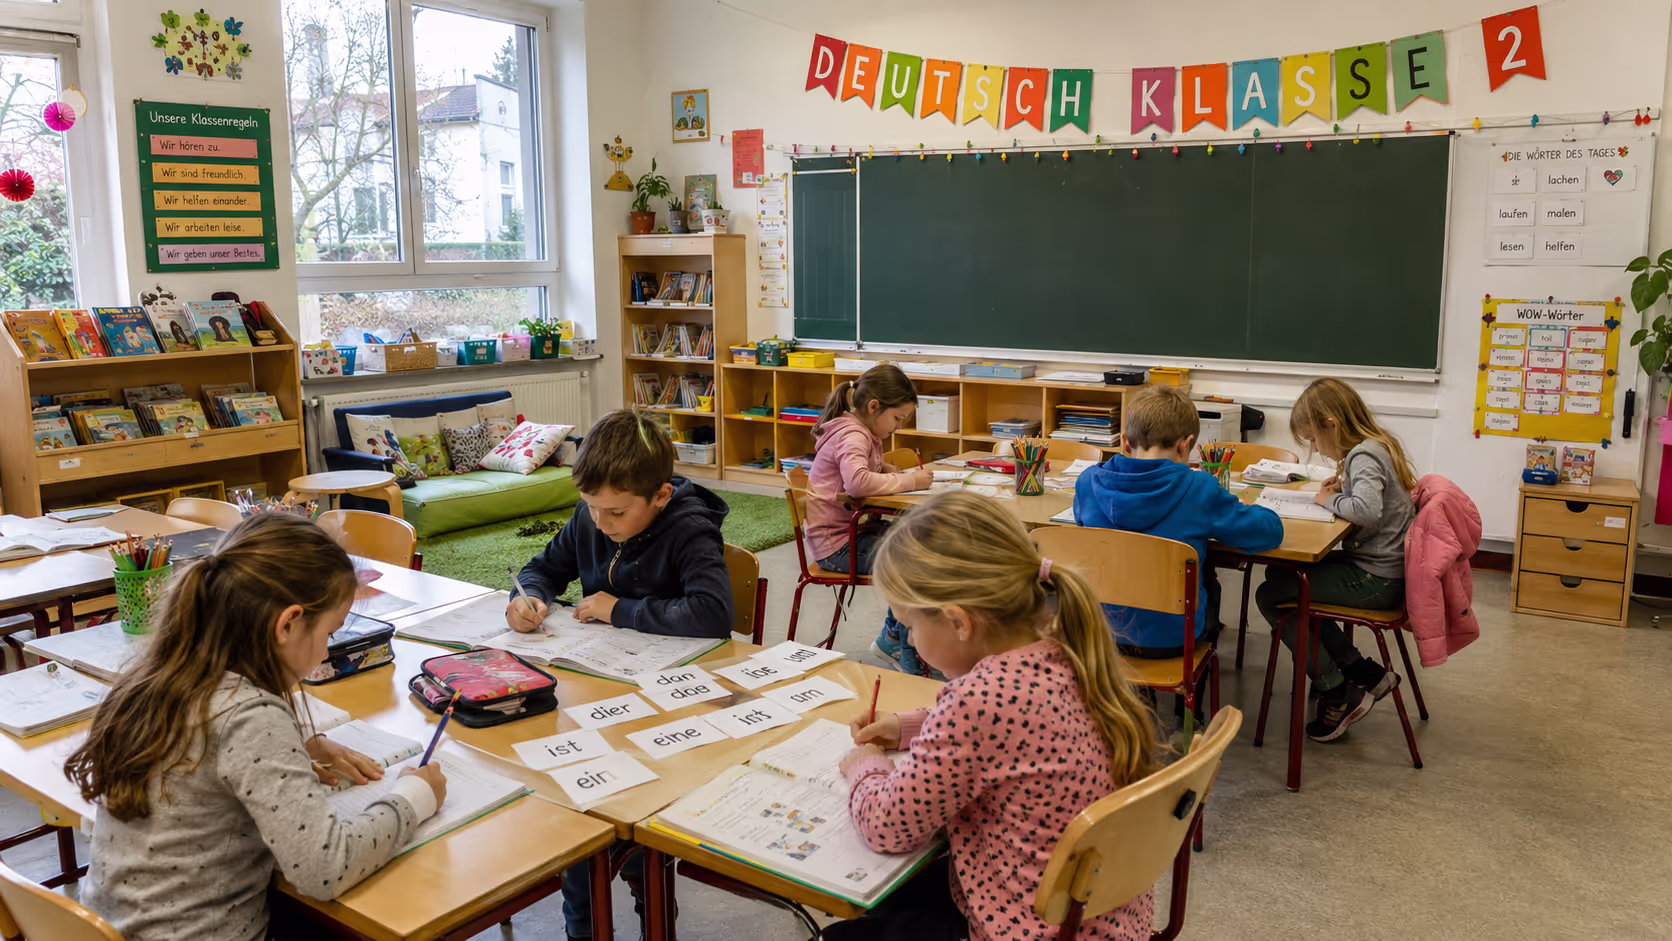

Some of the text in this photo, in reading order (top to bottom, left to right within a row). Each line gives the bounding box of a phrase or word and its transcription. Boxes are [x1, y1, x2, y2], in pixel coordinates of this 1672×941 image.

[814, 25, 1527, 117] DEUTSCH KLASSE 2
[149, 111, 258, 130] Unsere Klassenregeln
[160, 139, 221, 152] Wir hören zu.
[1508, 147, 1616, 161] DIE WÖRTER DES TAGES
[161, 167, 247, 180] Wir sind freundlich.
[1548, 174, 1579, 185] lachen
[163, 194, 250, 206] Wir helfen einander.
[1499, 208, 1528, 219] laufen
[1546, 207, 1577, 218] malen
[165, 221, 245, 232] Wir arbeiten leise.
[1500, 241, 1524, 251] lesen
[1545, 241, 1575, 251] helfen
[166, 249, 180, 259] Wir
[184, 248, 207, 261] geben
[210, 249, 230, 259] unser
[590, 703, 631, 720] dier
[653, 728, 702, 747] eine
[545, 740, 583, 757] ist
